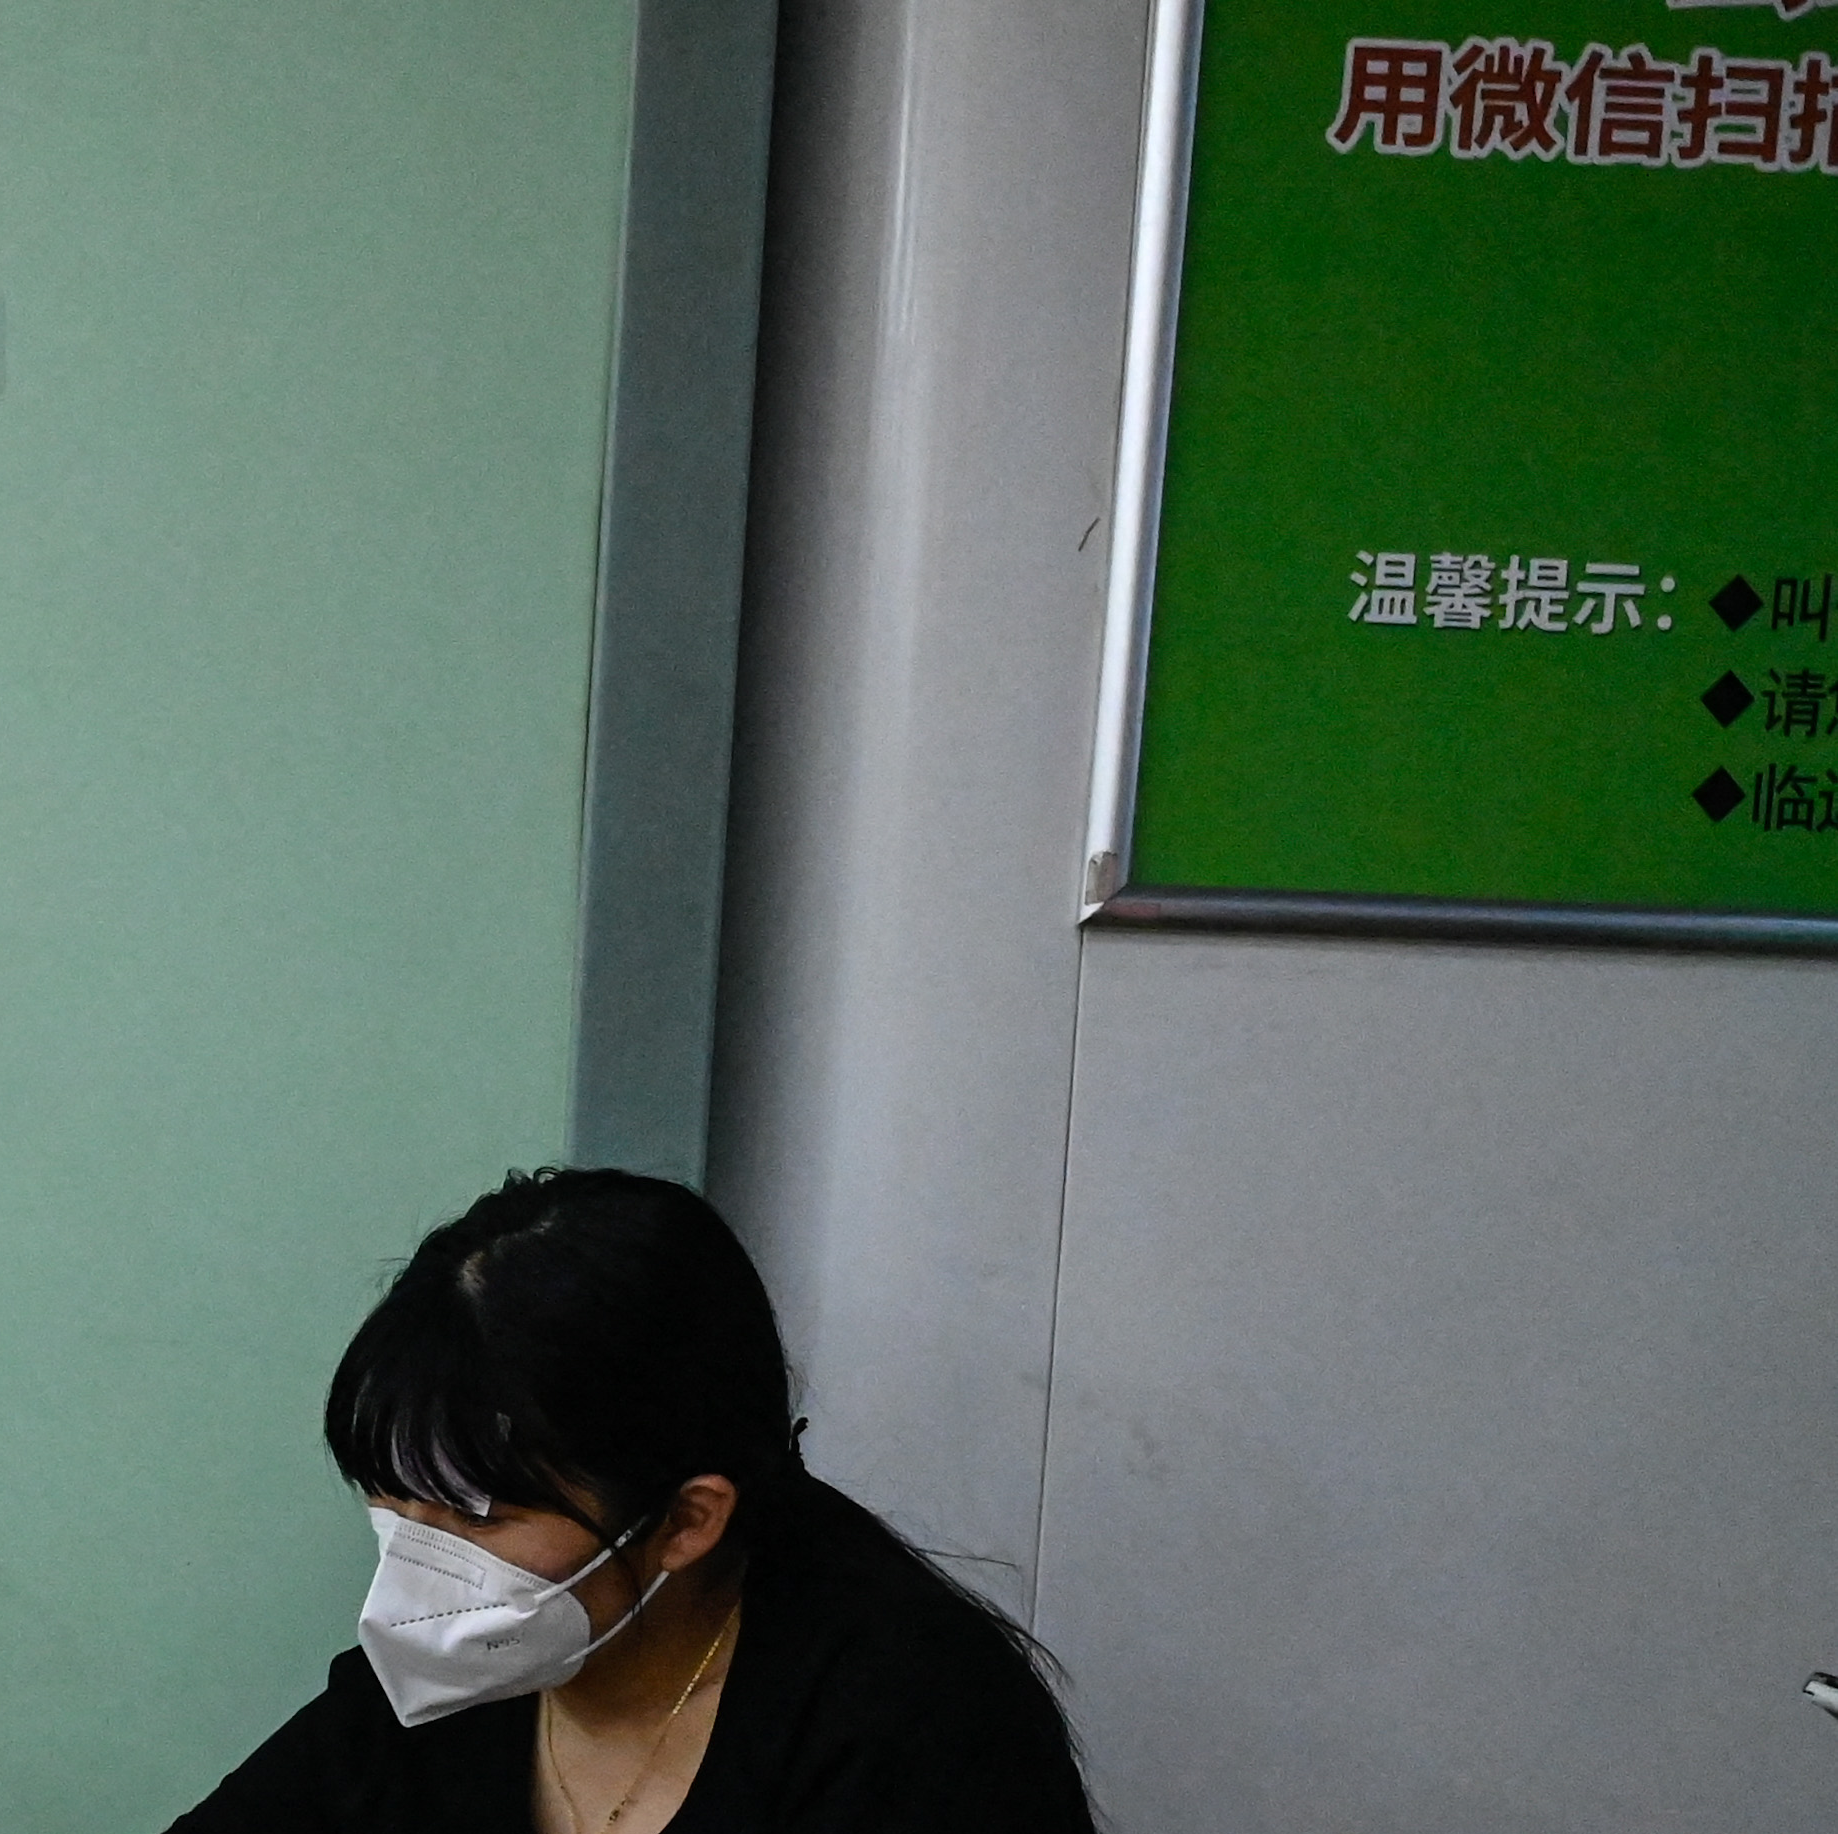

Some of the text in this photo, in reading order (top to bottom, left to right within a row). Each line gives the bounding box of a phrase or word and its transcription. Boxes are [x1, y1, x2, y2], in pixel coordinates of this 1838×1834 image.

[1347, 550, 1677, 635] 温馨提示：
[1760, 668, 1838, 738] 请
